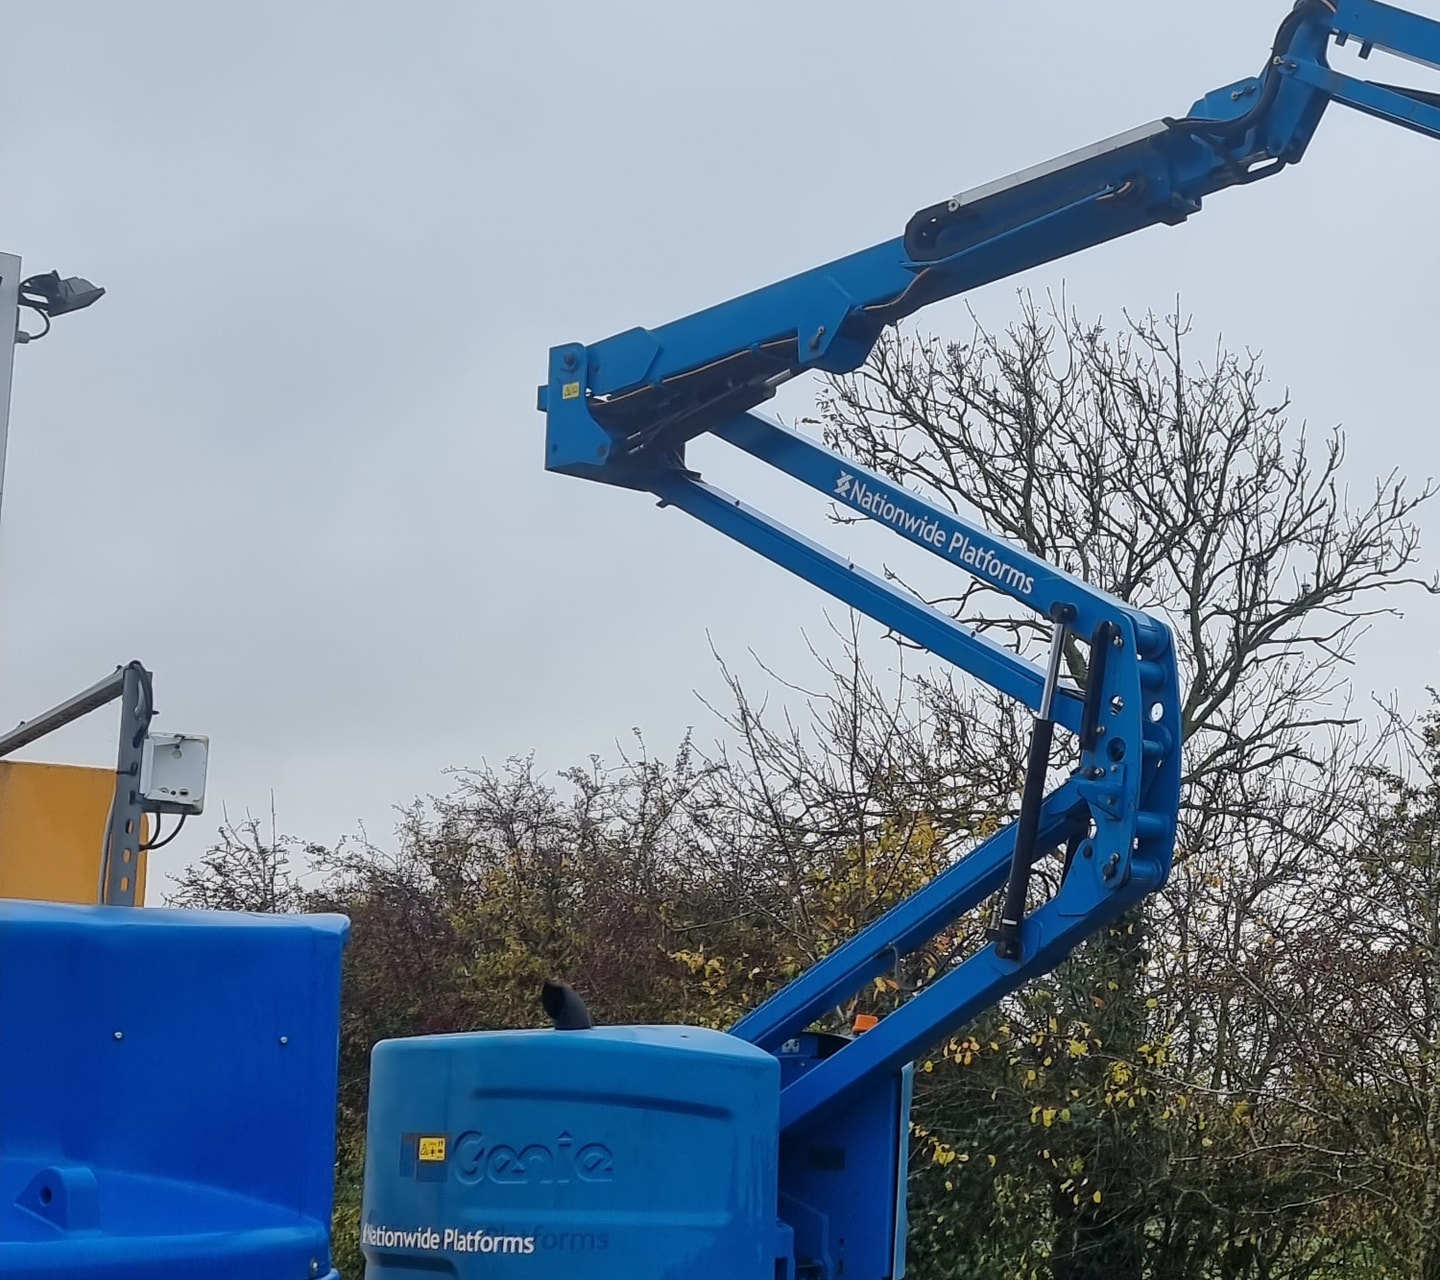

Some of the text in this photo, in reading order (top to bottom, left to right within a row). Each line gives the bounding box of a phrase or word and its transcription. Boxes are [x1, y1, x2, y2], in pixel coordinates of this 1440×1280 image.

[849, 478, 1035, 595] Nationwide Platforms
[453, 1129, 614, 1186] Genie
[443, 1228, 535, 1254] Platforms
